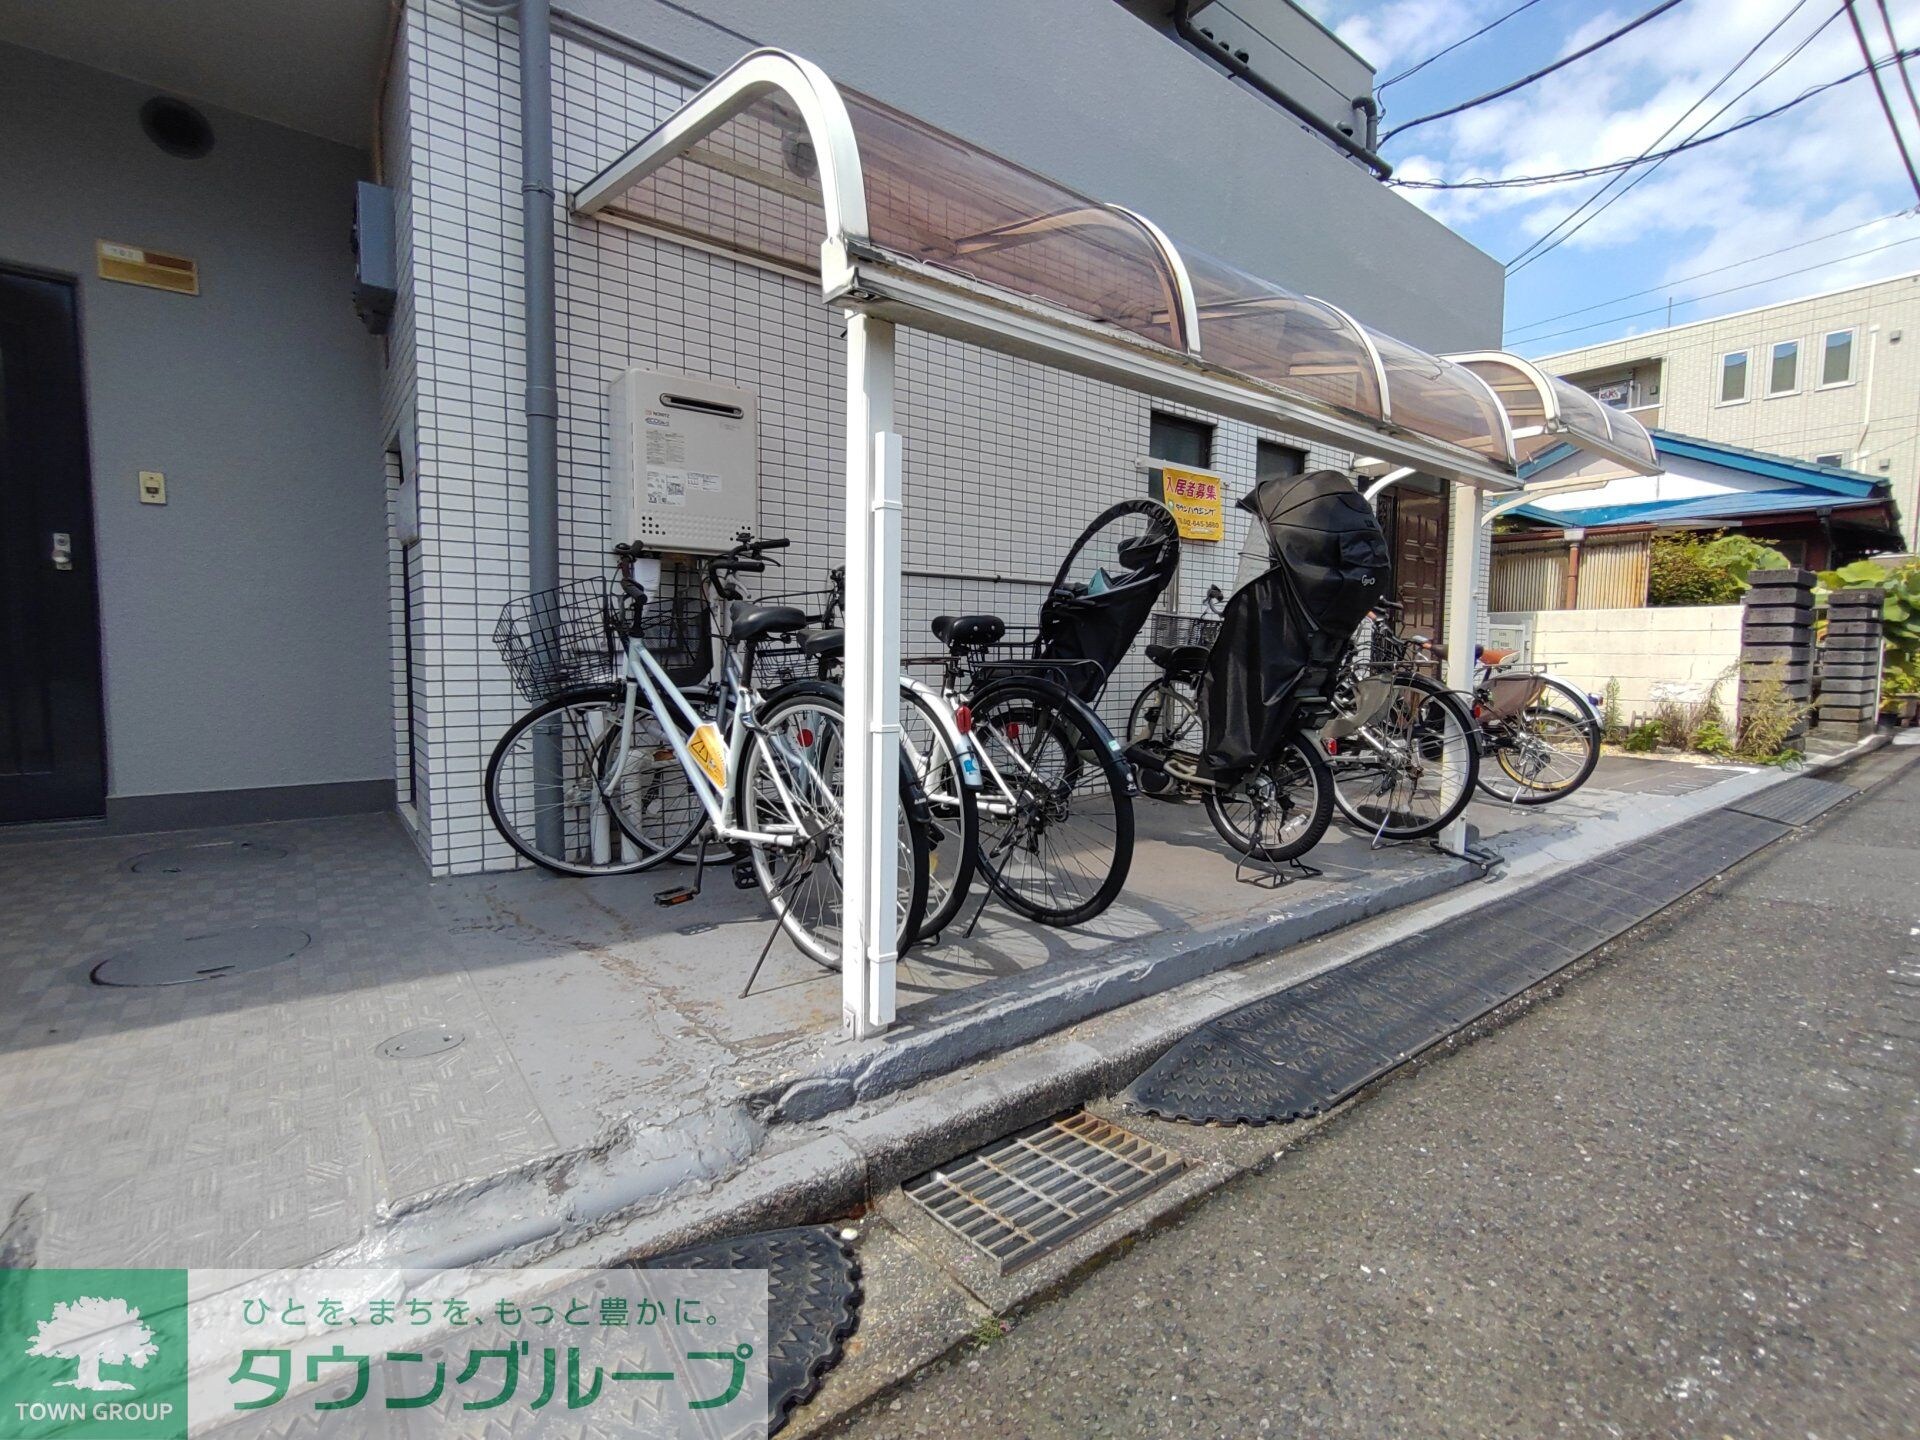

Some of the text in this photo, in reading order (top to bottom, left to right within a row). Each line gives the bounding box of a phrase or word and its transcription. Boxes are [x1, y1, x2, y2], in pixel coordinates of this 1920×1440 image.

[1166, 477, 1217, 500] 入居者募集
[1175, 503, 1216, 516] タウンハウジング
